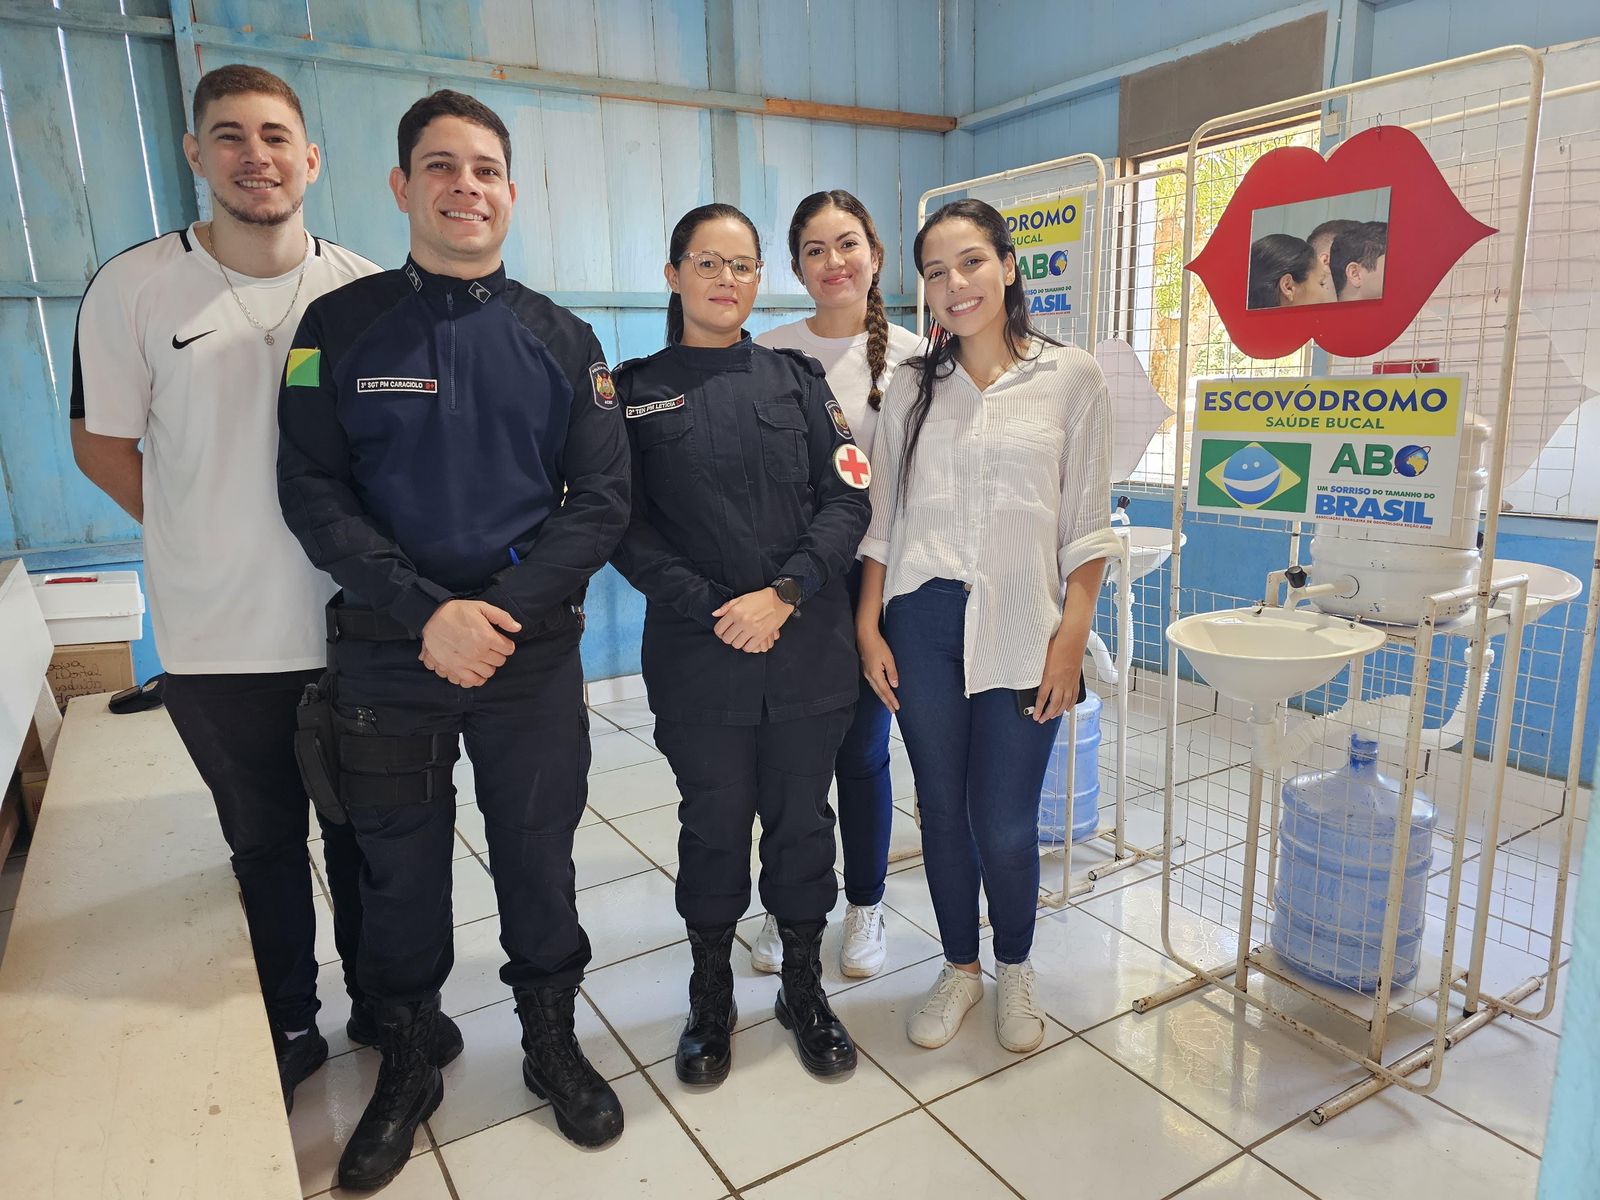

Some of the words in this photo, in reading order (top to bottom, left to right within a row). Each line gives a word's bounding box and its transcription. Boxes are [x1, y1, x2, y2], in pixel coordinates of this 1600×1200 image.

[1006, 204, 1077, 233] DROMO
[1204, 383, 1448, 413] ESCOVÓDROMO
[635, 407, 646, 415] TEN
[1265, 413, 1320, 429] SAÚDE
[1325, 417, 1385, 429] BUCAL
[1330, 485, 1371, 495] SORRISO
[1385, 490, 1422, 498] TAMANHO
[1315, 493, 1434, 525] BRASIL
